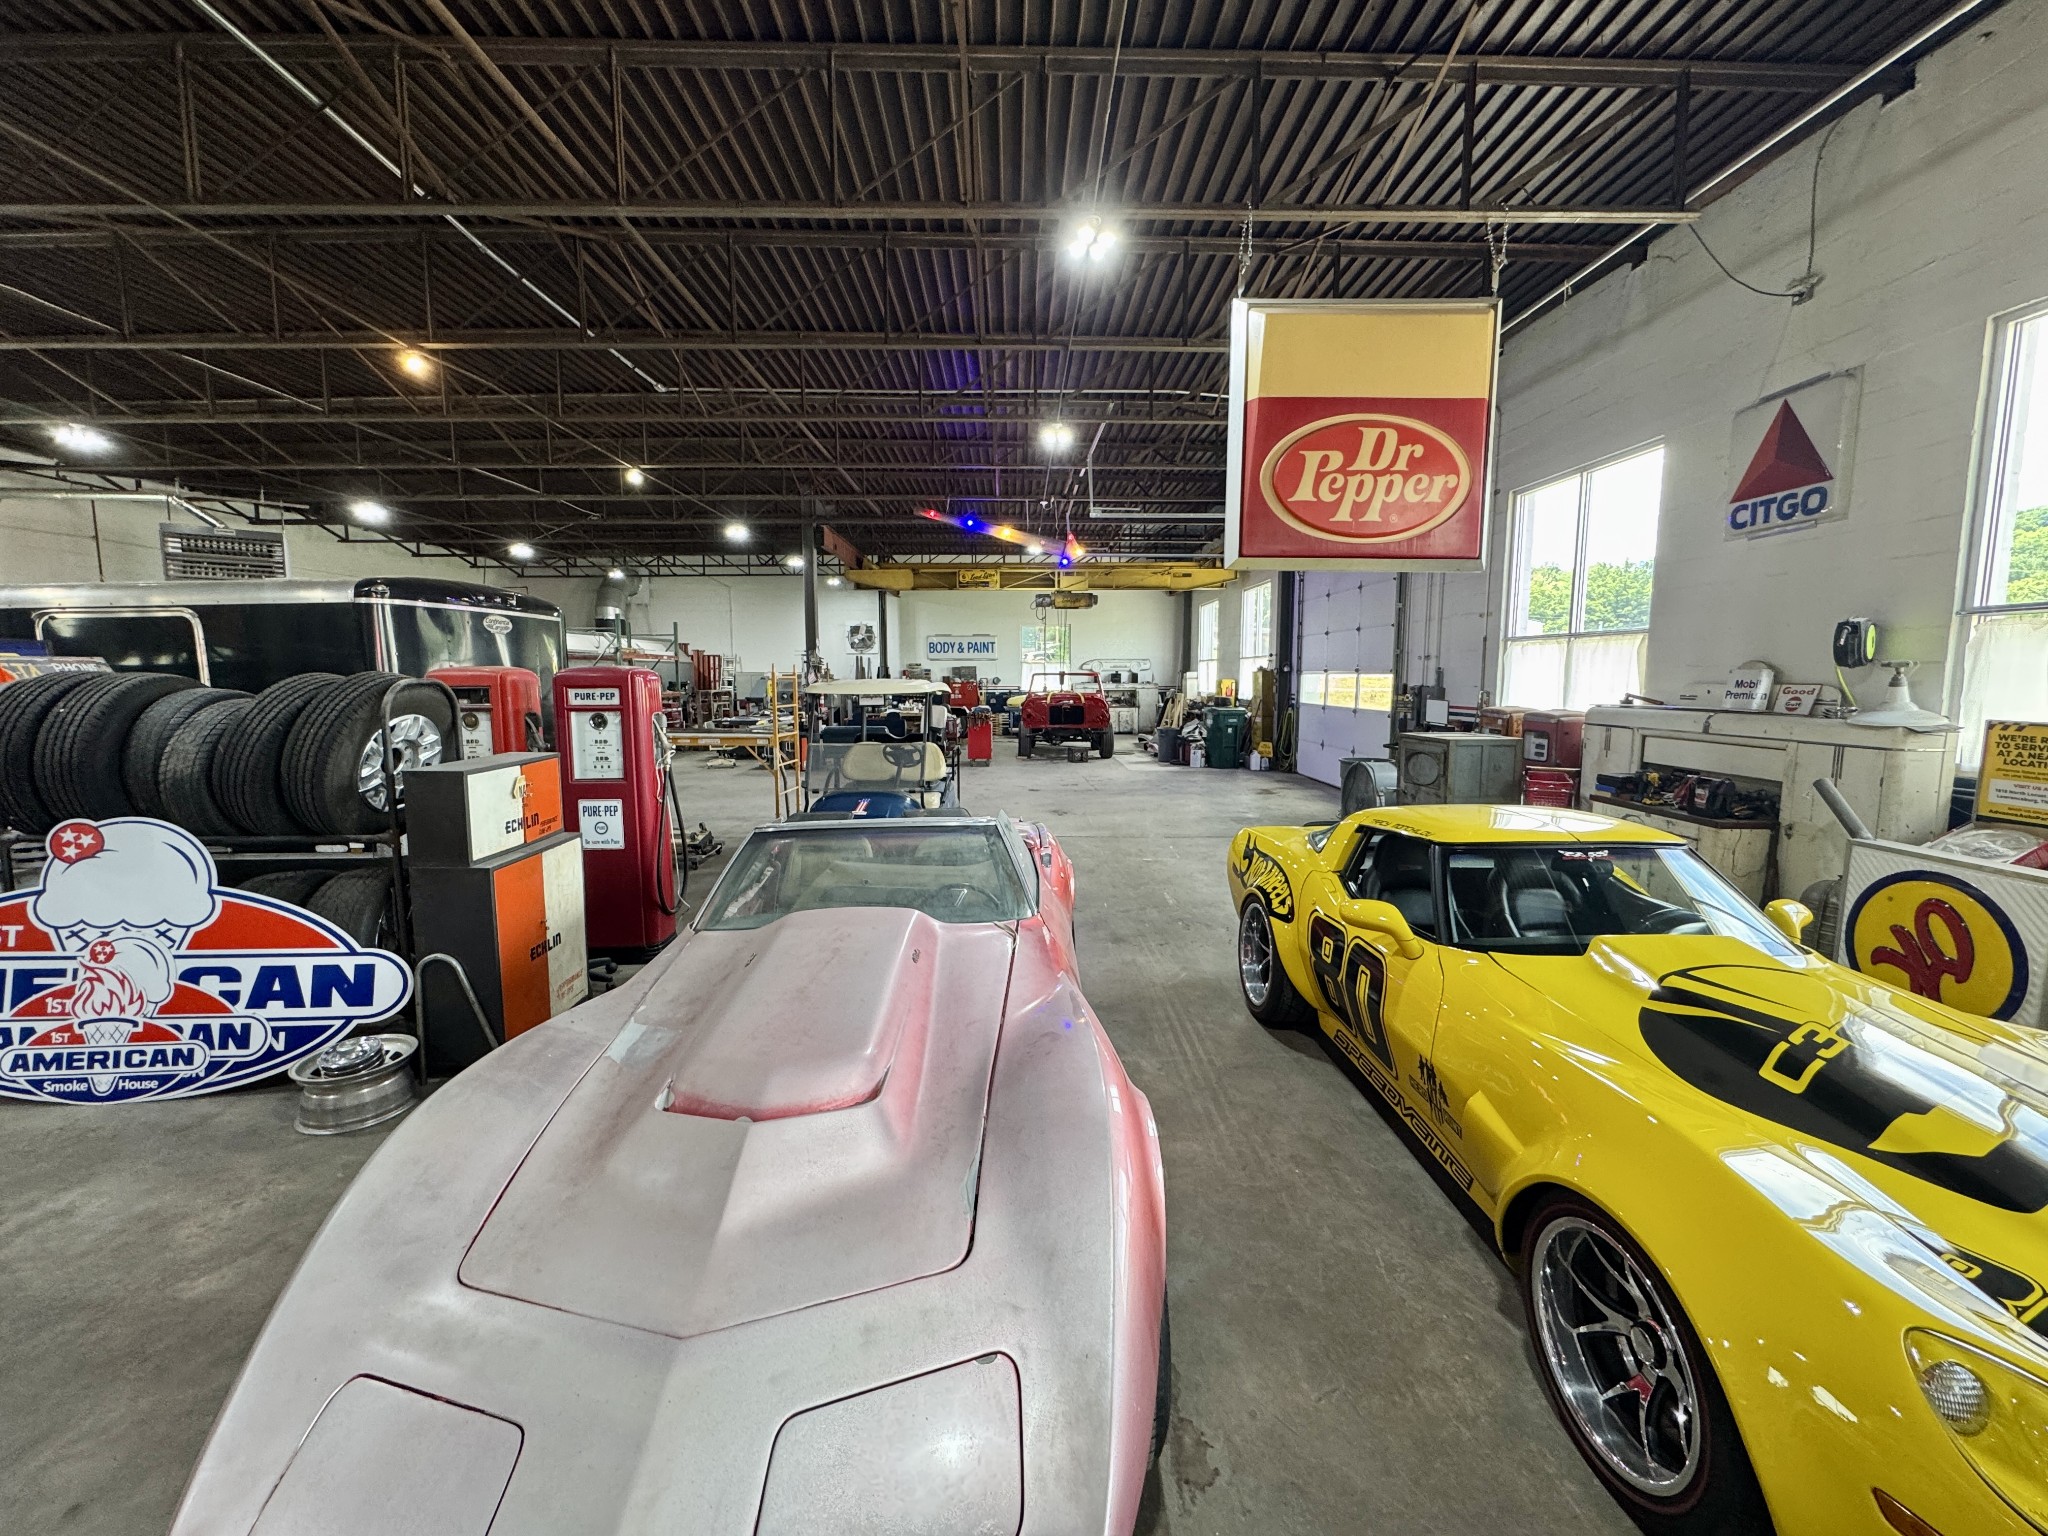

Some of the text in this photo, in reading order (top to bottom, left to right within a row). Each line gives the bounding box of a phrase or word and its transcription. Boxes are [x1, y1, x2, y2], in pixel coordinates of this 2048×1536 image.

[1346, 426, 1424, 471] Dr
[1287, 450, 1459, 522] Pepper
[1729, 486, 1828, 530] CITGO
[928, 642, 996, 653] BODY & PAINT
[574, 692, 616, 700] PURE-PEP
[1782, 686, 1817, 695] Good
[1998, 734, 2037, 743] WE'RE
[2014, 743, 2048, 752] SERV
[2003, 758, 2048, 769] LOCATI
[582, 805, 619, 817] PURE-PEP
[505, 812, 540, 834] ECHLIN
[529, 932, 562, 962] ECHLIN
[1307, 909, 1399, 1081] 80
[45, 997, 71, 1014] 1ST
[50, 1031, 71, 1044] 1ST
[8, 1047, 196, 1072] AMERICAN
[42, 1077, 160, 1093] Smoke House
[1333, 1029, 1474, 1192] SPEEDVETTE
